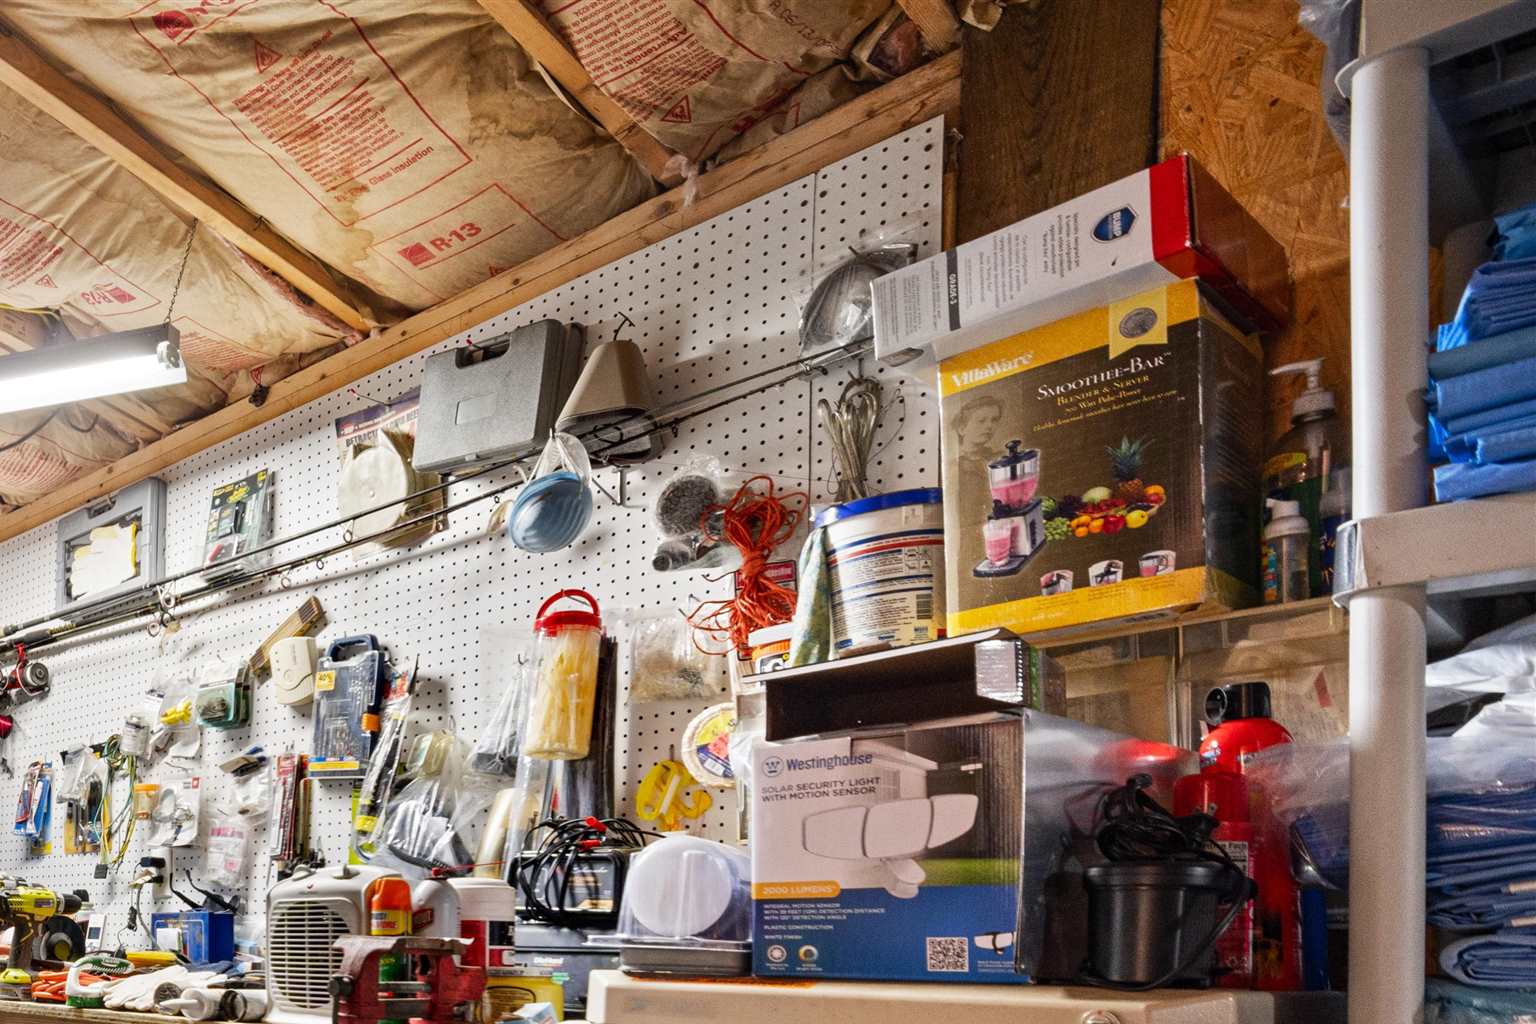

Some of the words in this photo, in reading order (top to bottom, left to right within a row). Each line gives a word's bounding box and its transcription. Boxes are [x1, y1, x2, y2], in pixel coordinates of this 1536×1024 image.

[390, 143, 435, 174] Insulation
[428, 221, 483, 252] R-13
[786, 754, 873, 772] Westinghouse
[762, 784, 794, 793] SOLAR
[796, 780, 844, 791] SECURITY
[849, 776, 880, 787] LIGHT
[761, 793, 786, 803] WITH
[789, 790, 829, 800] MOTION
[833, 786, 876, 796] SENSOR
